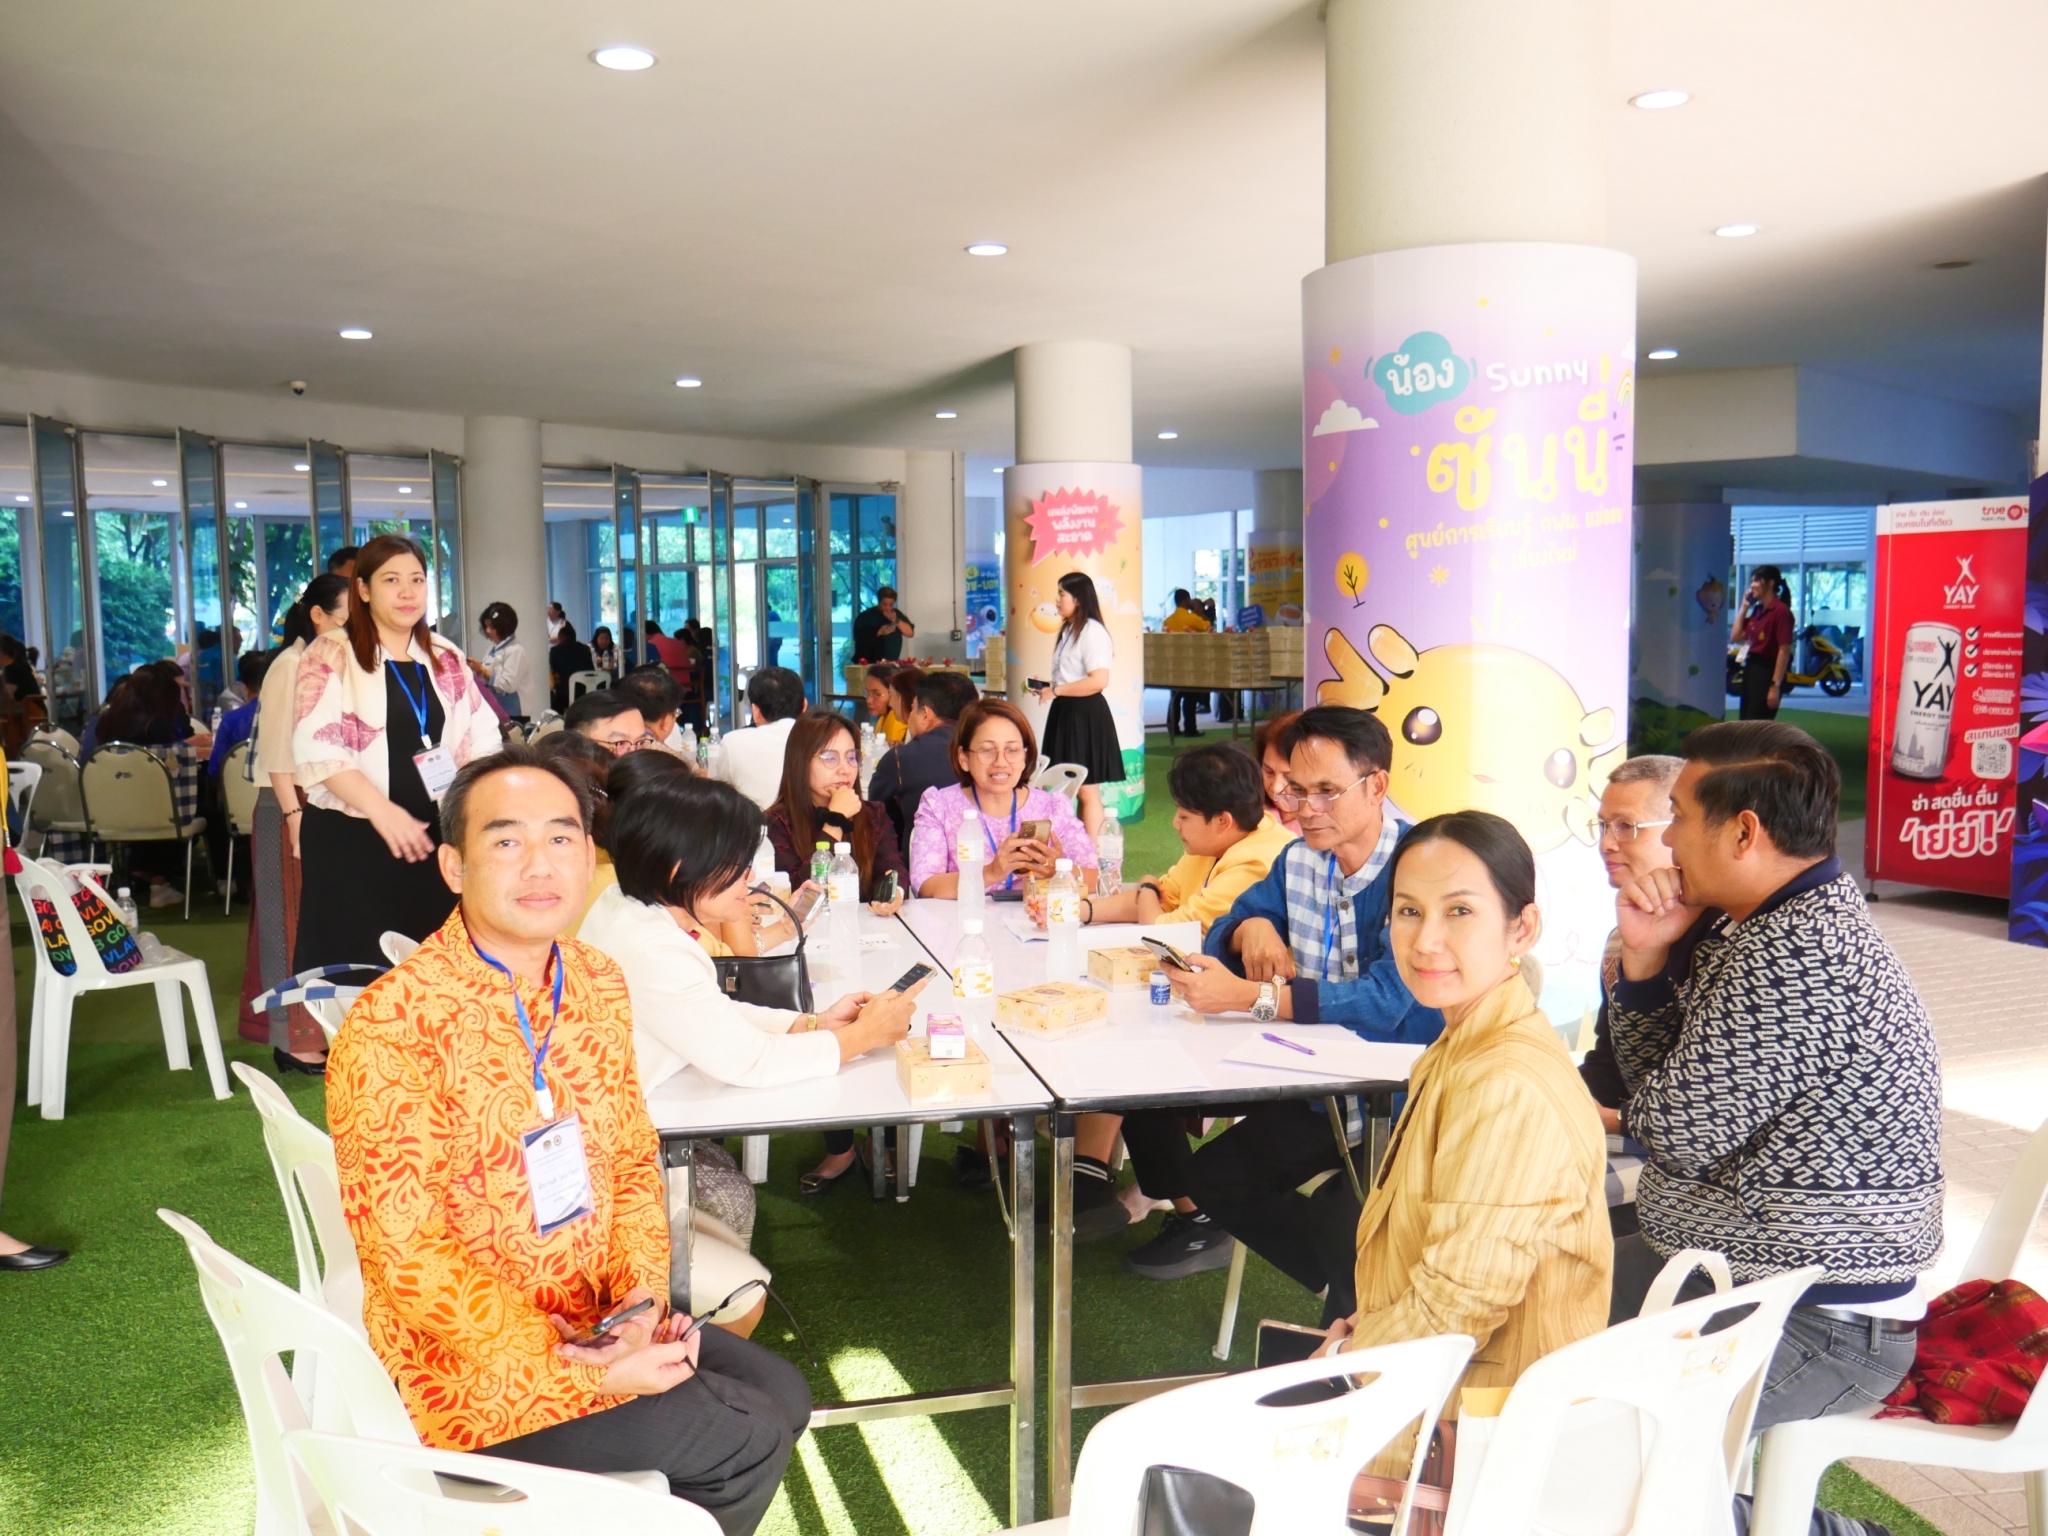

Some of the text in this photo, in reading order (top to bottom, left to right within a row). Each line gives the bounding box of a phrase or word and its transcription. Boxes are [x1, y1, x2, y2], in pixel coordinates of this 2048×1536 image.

[1386, 353, 1455, 396] น้อง
[1485, 359, 1589, 392] Sunny
[1982, 506, 2006, 516] true
[1943, 584, 1980, 604] YAY
[1910, 710, 1936, 719] ENERGY
[1965, 725, 2019, 742] สแกนเลย!
[1912, 784, 1998, 811] ซ่า สดชื่น ตื่น
